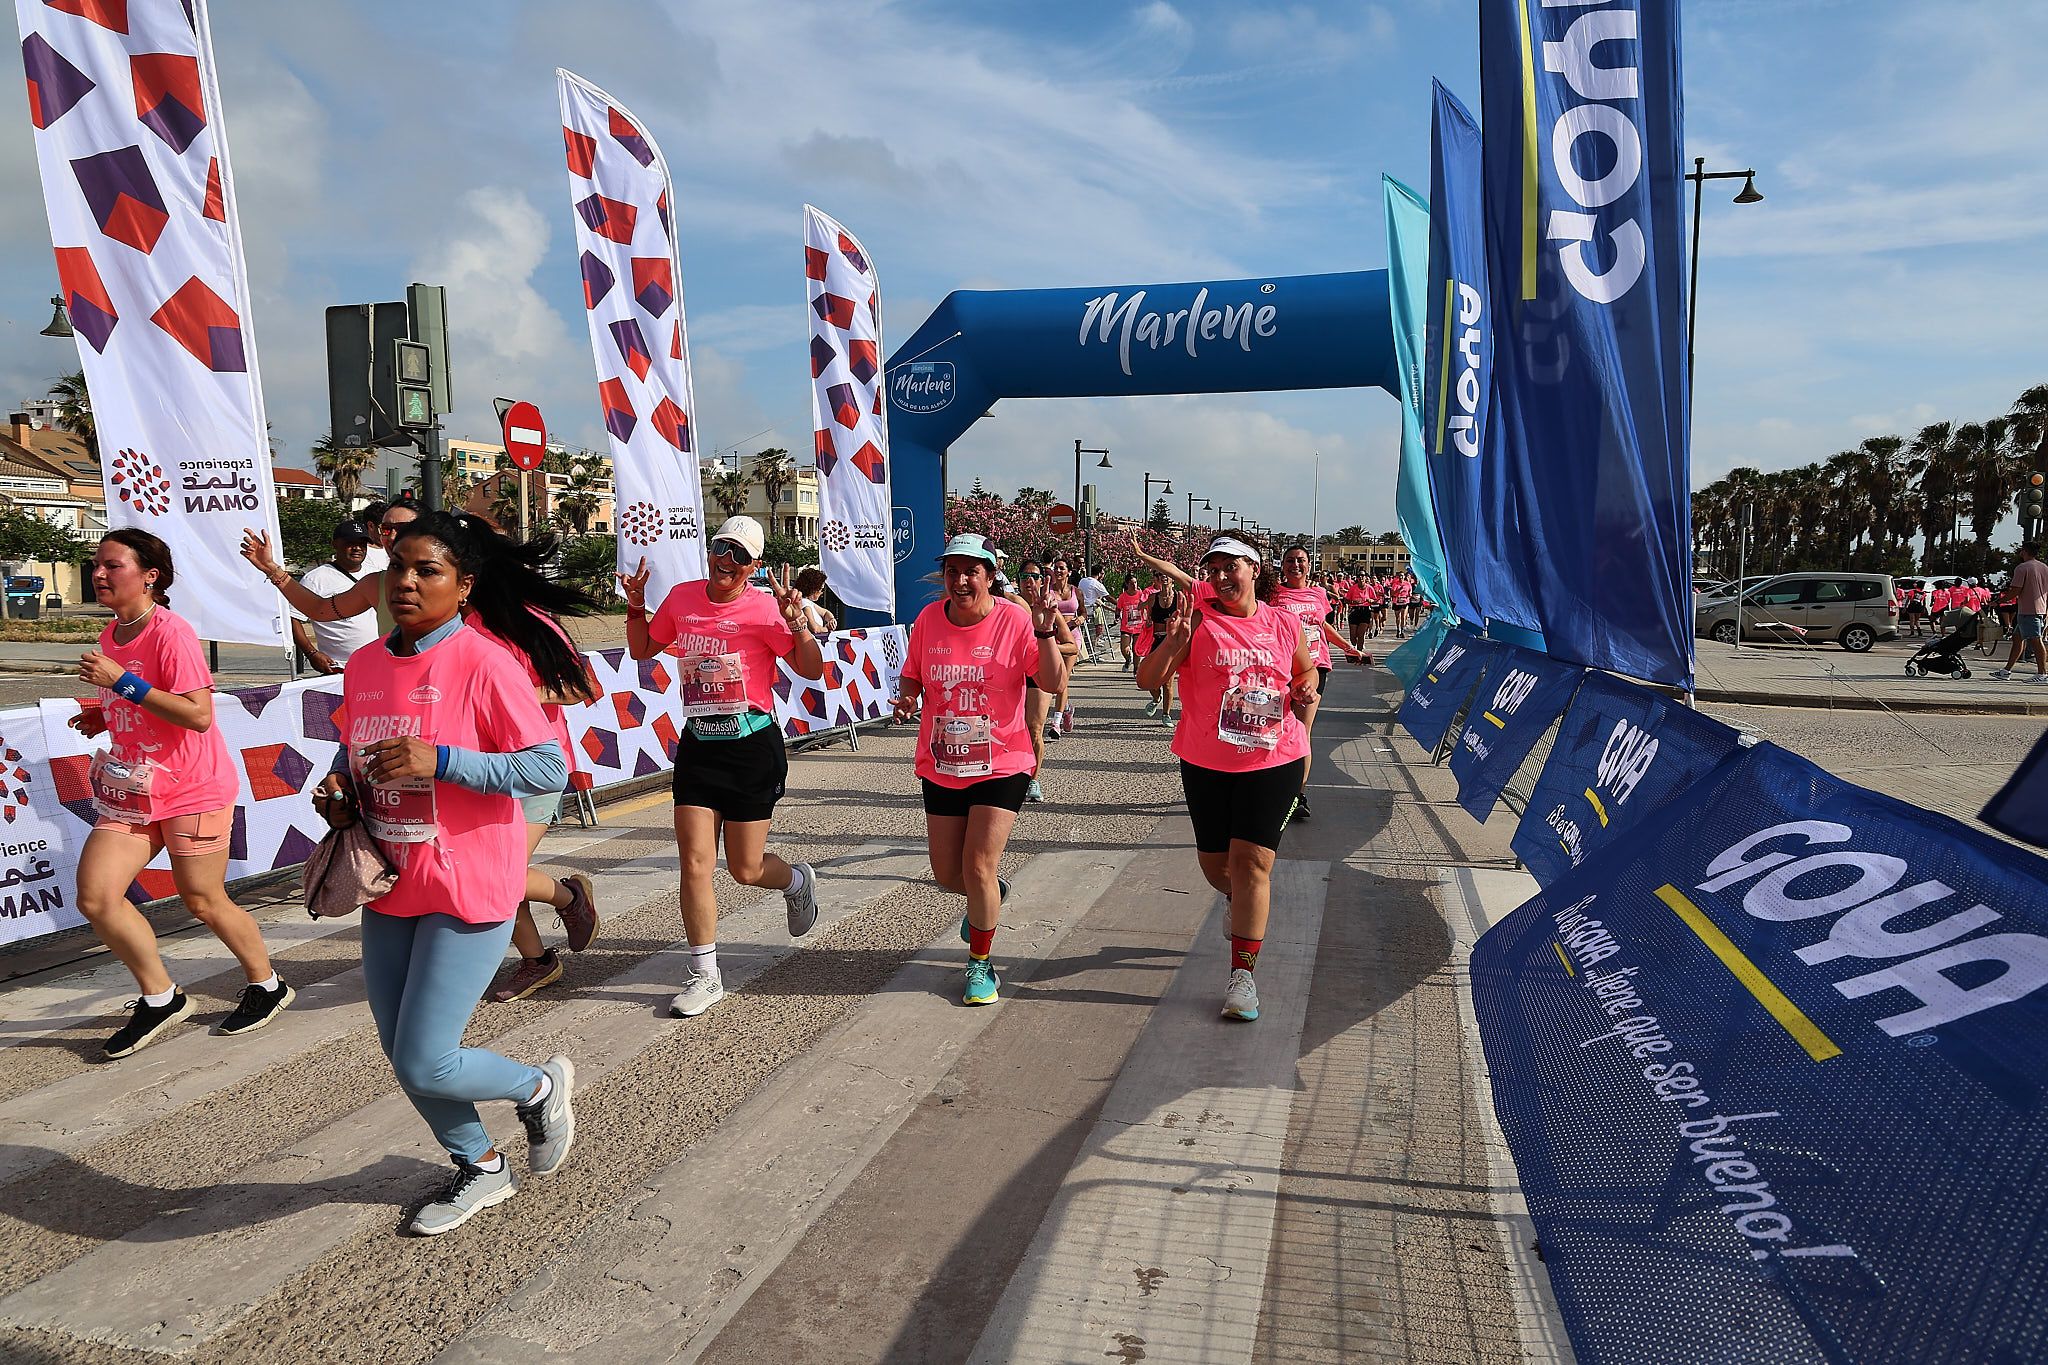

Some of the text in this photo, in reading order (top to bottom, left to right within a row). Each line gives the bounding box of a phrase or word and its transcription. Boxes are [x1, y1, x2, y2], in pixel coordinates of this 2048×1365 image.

[1079, 287, 1277, 376] Marlene
[895, 373, 951, 400] Marlene
[930, 398, 947, 410] ALPES
[678, 632, 728, 656] CARRERA
[1216, 648, 1274, 668] CARRERA
[930, 664, 984, 682] CARRERA
[702, 682, 725, 693] 016
[1491, 668, 1538, 716] GOYA
[959, 688, 978, 712] DE
[115, 707, 134, 732] DE
[351, 714, 422, 742] CARRERA
[696, 718, 740, 732] BENICÀSSIM
[1242, 714, 1267, 726] 016
[946, 744, 970, 755] 016
[1596, 718, 1659, 806] GOYA
[102, 785, 127, 801] 016
[372, 788, 400, 806] 016
[0, 839, 48, 858] ience
[1695, 820, 2048, 1038] GOYA
[1584, 966, 1643, 1016] tiene
[1579, 1016, 1674, 1058] que
[1643, 1062, 1710, 1108] ser
[1680, 1111, 1859, 1261] bueno!
